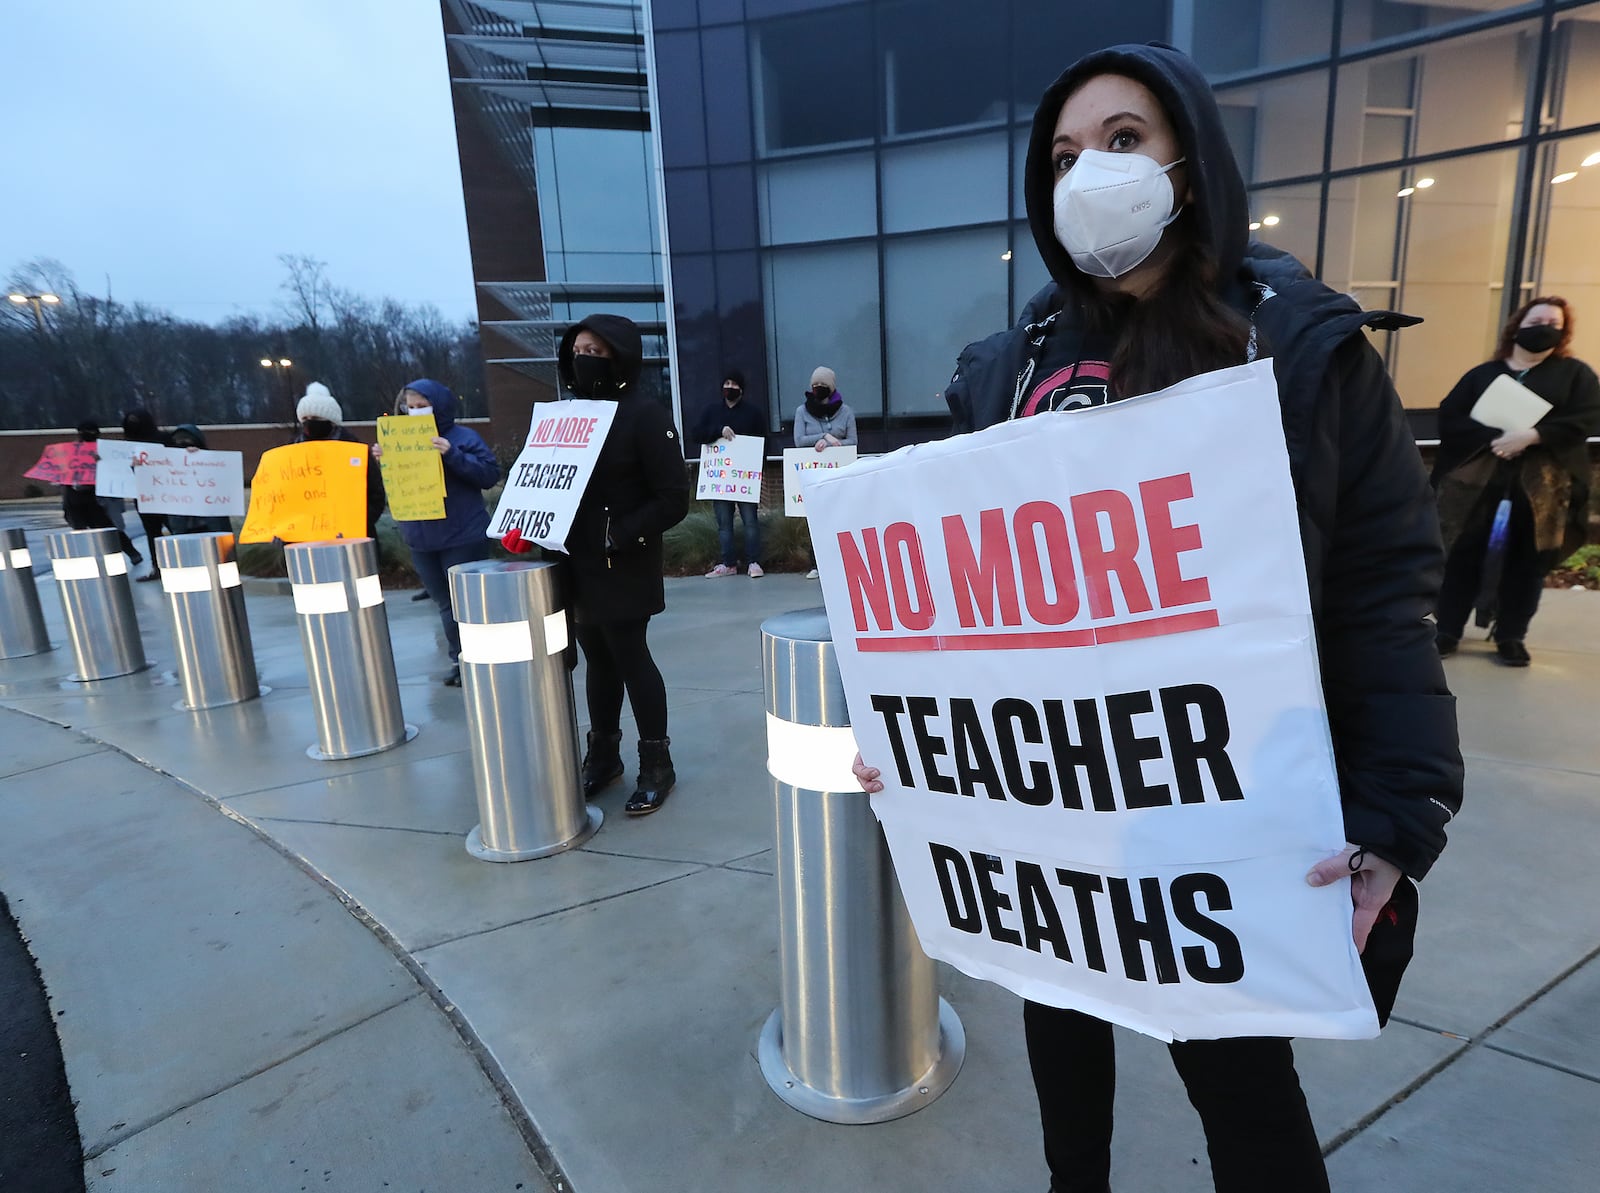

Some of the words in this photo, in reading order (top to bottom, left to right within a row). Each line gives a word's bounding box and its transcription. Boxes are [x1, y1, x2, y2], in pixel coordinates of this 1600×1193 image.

[531, 418, 555, 443] NO
[550, 417, 599, 444] MORE
[152, 475, 187, 486] KILL
[197, 478, 216, 488] US
[514, 463, 578, 490] TEACHER
[204, 494, 231, 505] CAN
[303, 480, 328, 501] and
[497, 508, 556, 539] DEATHS
[837, 521, 936, 632] NO
[941, 472, 1212, 629] MORE
[870, 683, 1245, 812] TEACHER
[928, 842, 1245, 985] DEATHS
